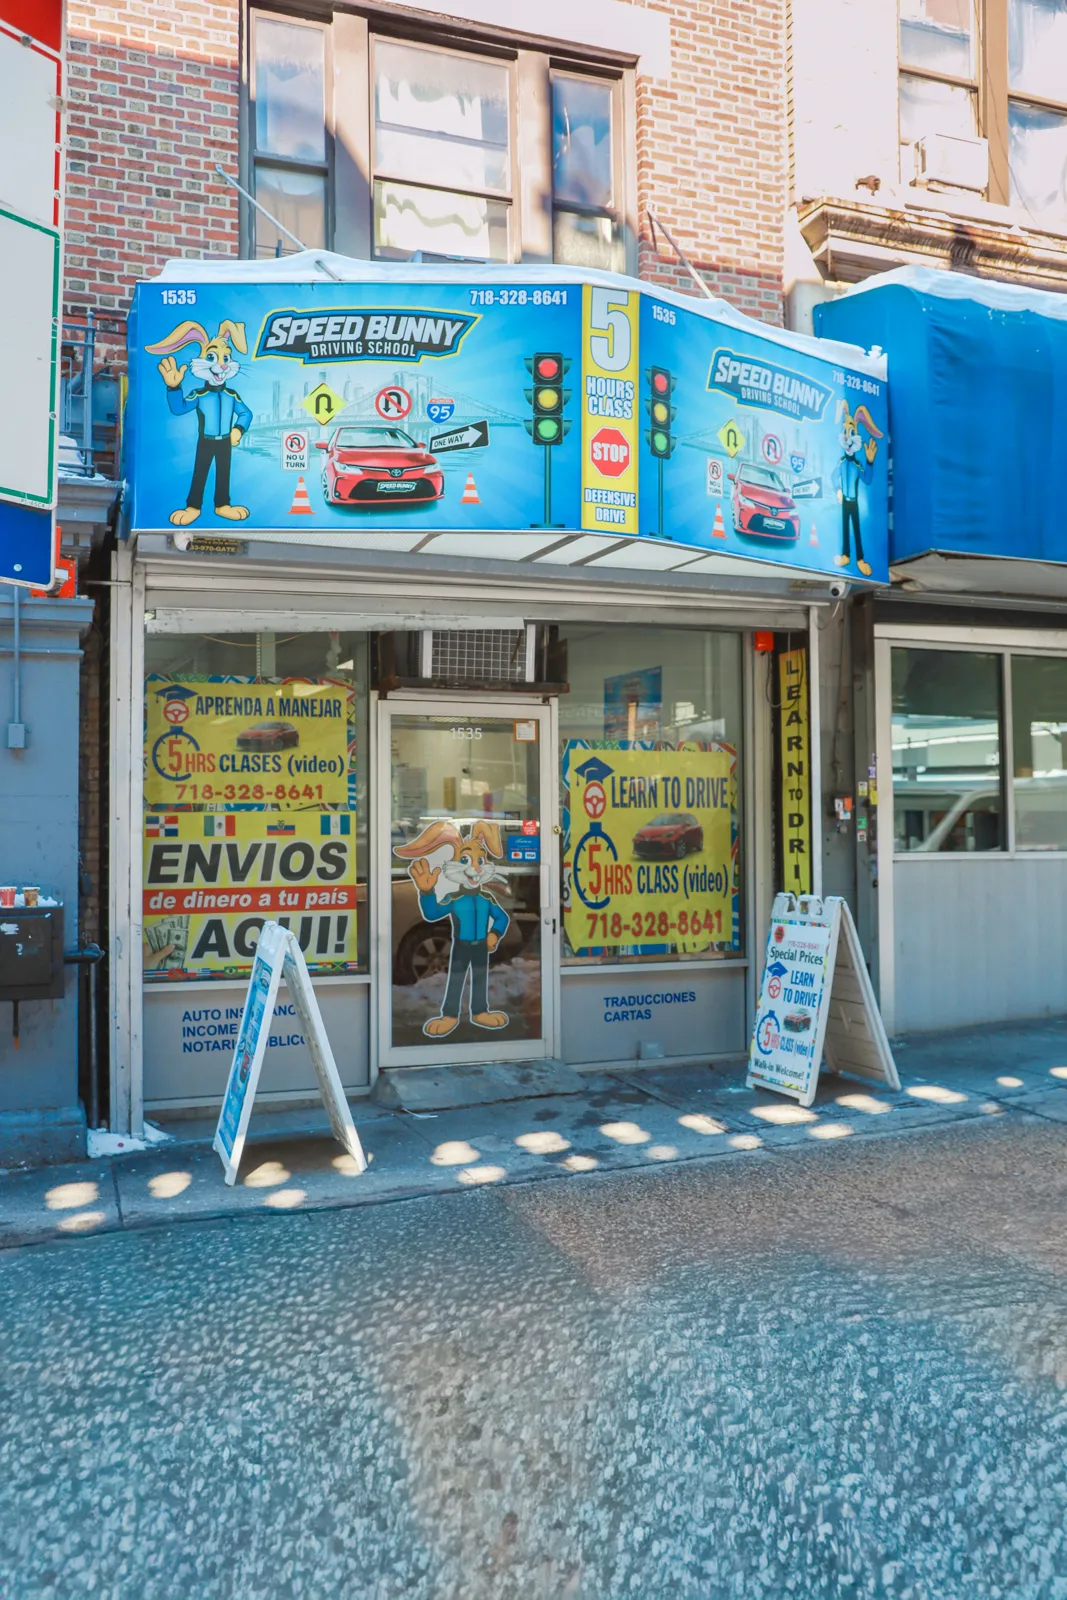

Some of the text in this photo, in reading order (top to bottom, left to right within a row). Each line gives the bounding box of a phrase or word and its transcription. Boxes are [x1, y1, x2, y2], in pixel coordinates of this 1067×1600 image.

[161, 290, 196, 305] 1535
[470, 290, 567, 305] 718-328-8641
[651, 304, 676, 326] 1535
[266, 314, 463, 348] SPEED BUNNY
[590, 286, 631, 372] 5
[311, 341, 416, 357] DRIVING SCHOOL
[586, 376, 635, 400] HOURS
[714, 356, 825, 412] SPEED BUNNY
[832, 370, 880, 396] 718-328-8641
[588, 395, 633, 420] CLASS
[740, 386, 801, 415] DRIVING SCHOOL
[430, 405, 451, 420] 95
[434, 434, 465, 448] ONE WAY
[592, 441, 629, 464] STOP
[791, 457, 804, 471] 95
[584, 488, 636, 507] DEFENSIVE
[596, 507, 626, 524] DRIVE
[195, 696, 342, 718] APRENDA A MANEJAR
[786, 659, 803, 778] LEARN
[450, 727, 482, 740] 1535
[168, 739, 344, 777] 5 HRS CLASES (video)
[175, 784, 323, 800] 718-328-8641
[611, 776, 728, 809] LEARN TO DRIVE
[788, 787, 803, 801] TO
[147, 841, 348, 884] ENVIOS
[588, 844, 729, 900] 5 HRS CLASS (video)
[149, 888, 348, 909] de dinero a tu país
[586, 909, 723, 939] 718-328-8641
[770, 946, 824, 965] Special Prices
[790, 970, 815, 988] LEARN
[604, 991, 697, 1008] TRADUCCIONES
[783, 988, 817, 1008] TO DRIVE
[182, 1009, 222, 1022] AUTO
[604, 1008, 652, 1023] CARTAS
[183, 1023, 238, 1037] INCOME
[763, 1022, 772, 1047] 5
[183, 1040, 237, 1053] NOTARI
[754, 1057, 805, 1080] Walk-in Welcome!
